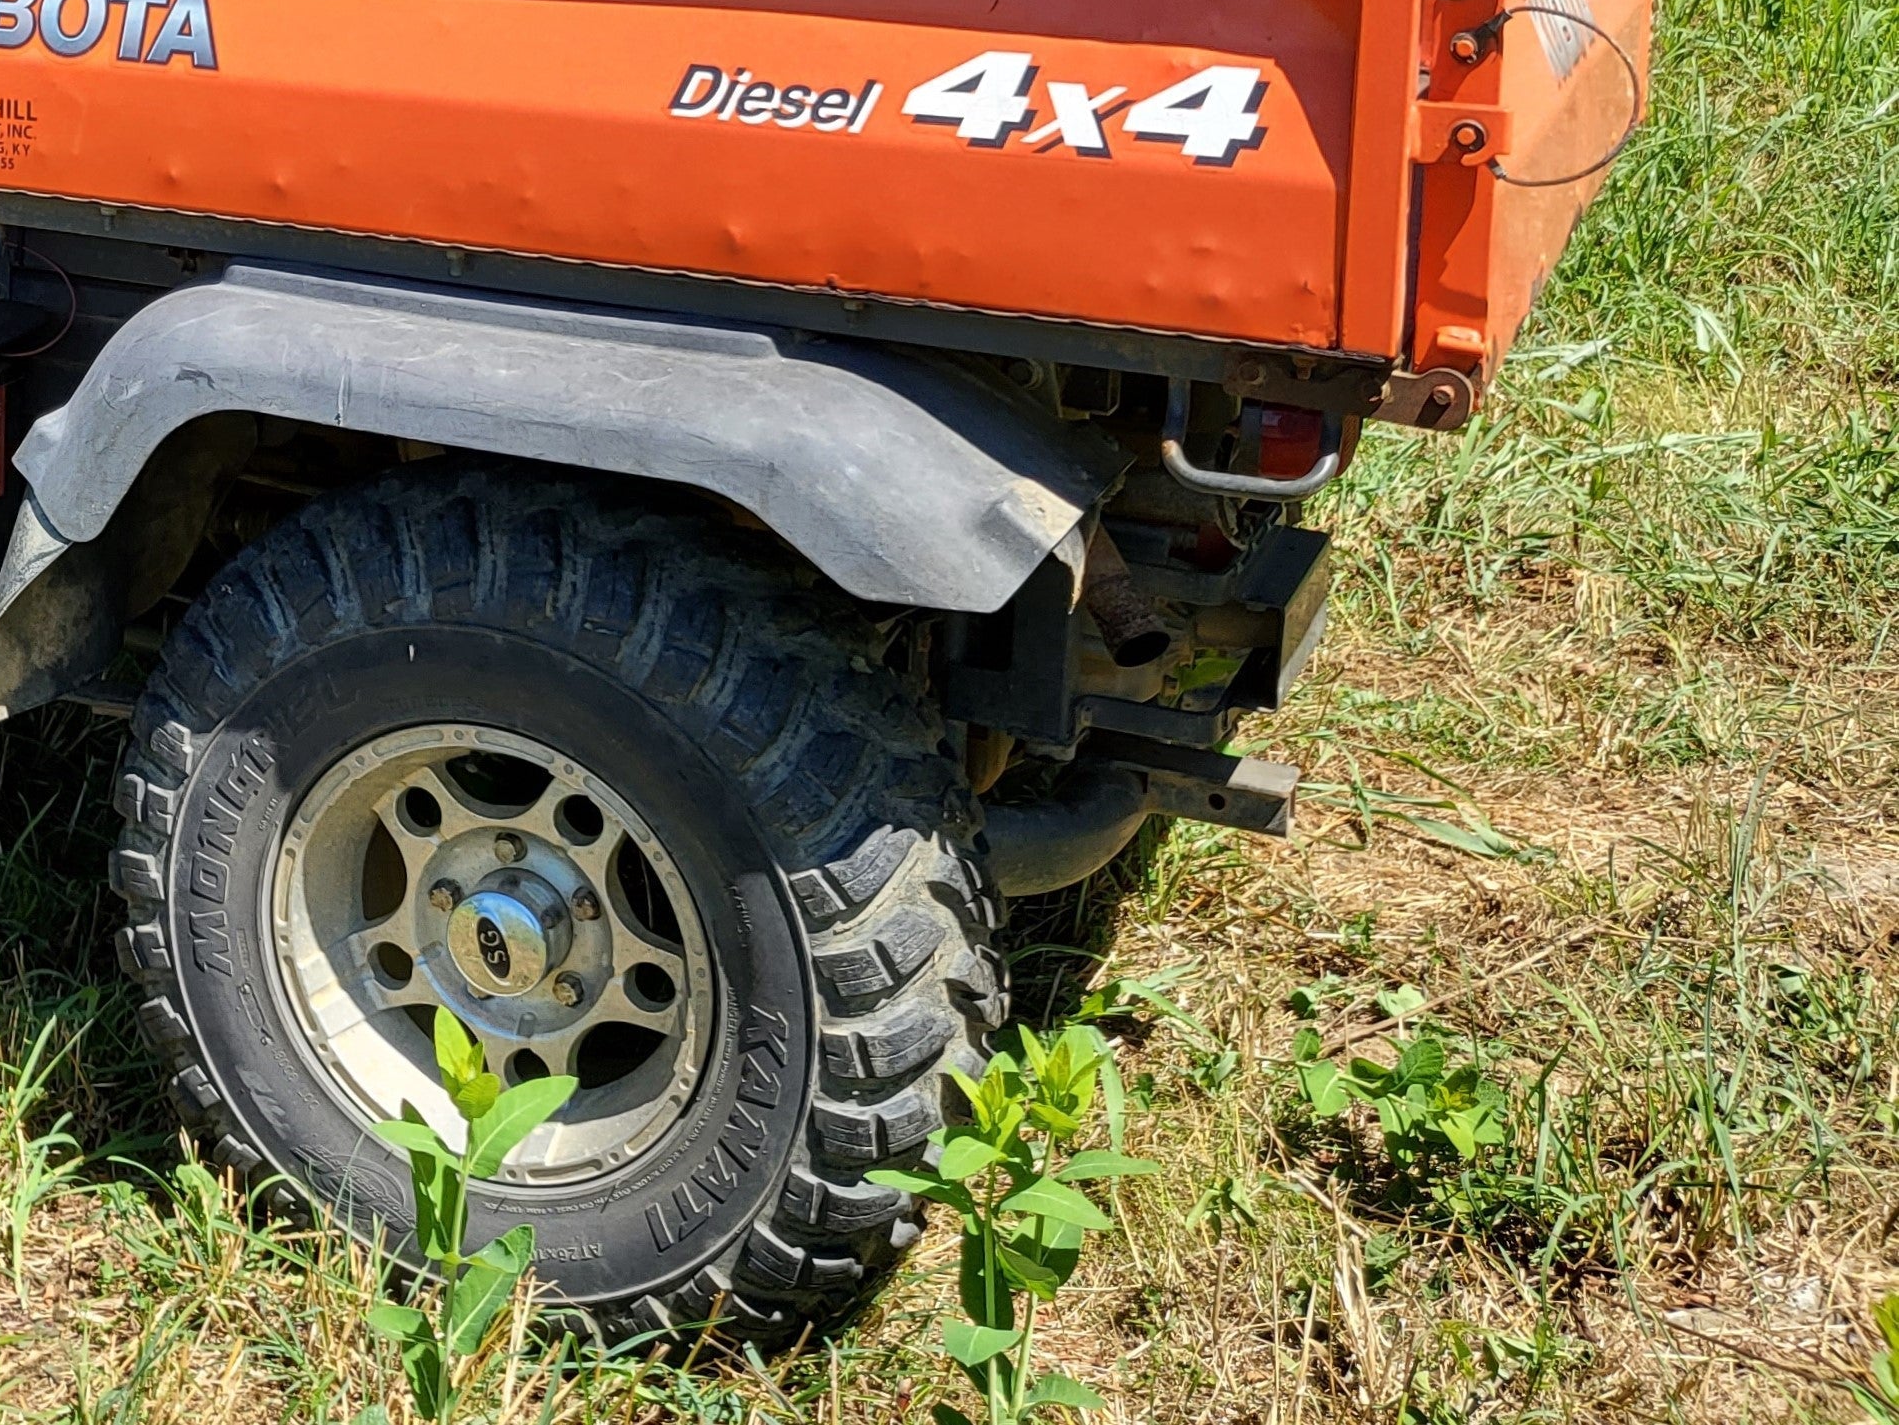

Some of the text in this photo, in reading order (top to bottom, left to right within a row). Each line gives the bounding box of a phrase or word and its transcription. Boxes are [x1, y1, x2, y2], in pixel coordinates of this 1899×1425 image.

[6, 124, 38, 141] INC.
[668, 49, 1270, 169] Diesel 4x4
